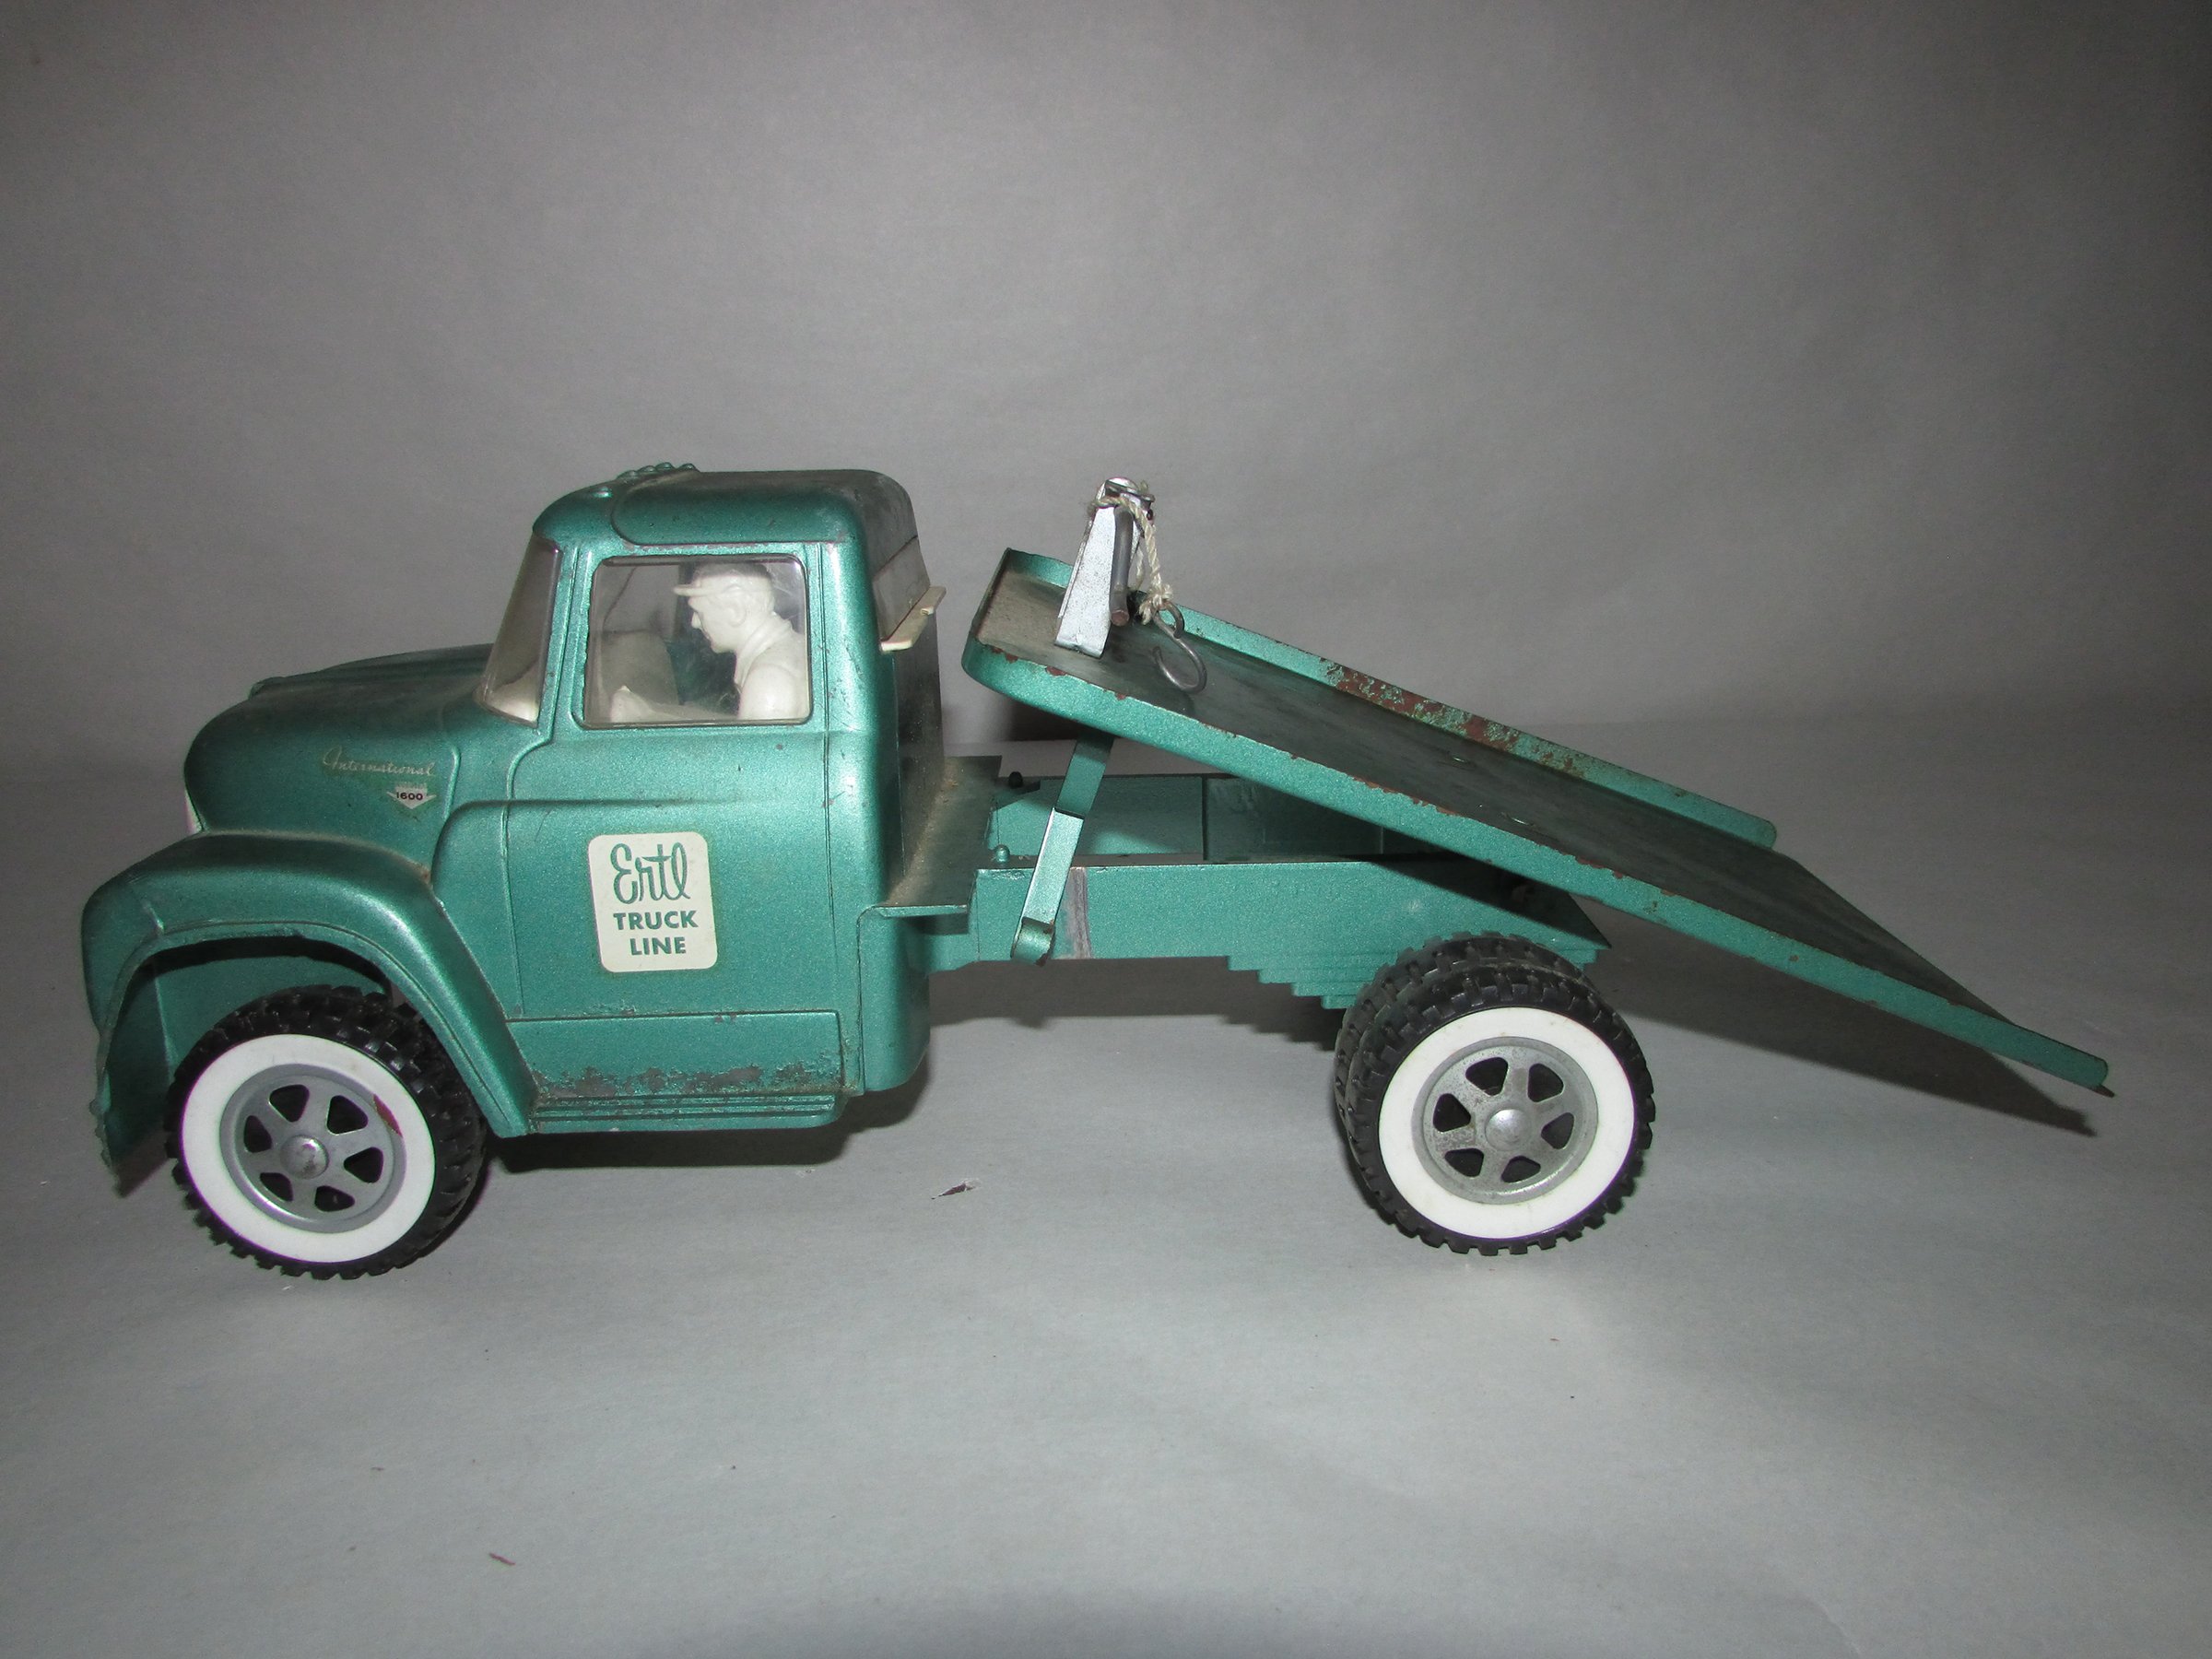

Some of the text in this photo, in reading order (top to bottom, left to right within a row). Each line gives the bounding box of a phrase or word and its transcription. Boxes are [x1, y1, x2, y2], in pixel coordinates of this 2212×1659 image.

[323, 746, 436, 776] International
[396, 791, 423, 801] 1600
[610, 842, 690, 904] Ertl
[614, 911, 699, 930] TRUCK
[630, 936, 686, 955] LINE
